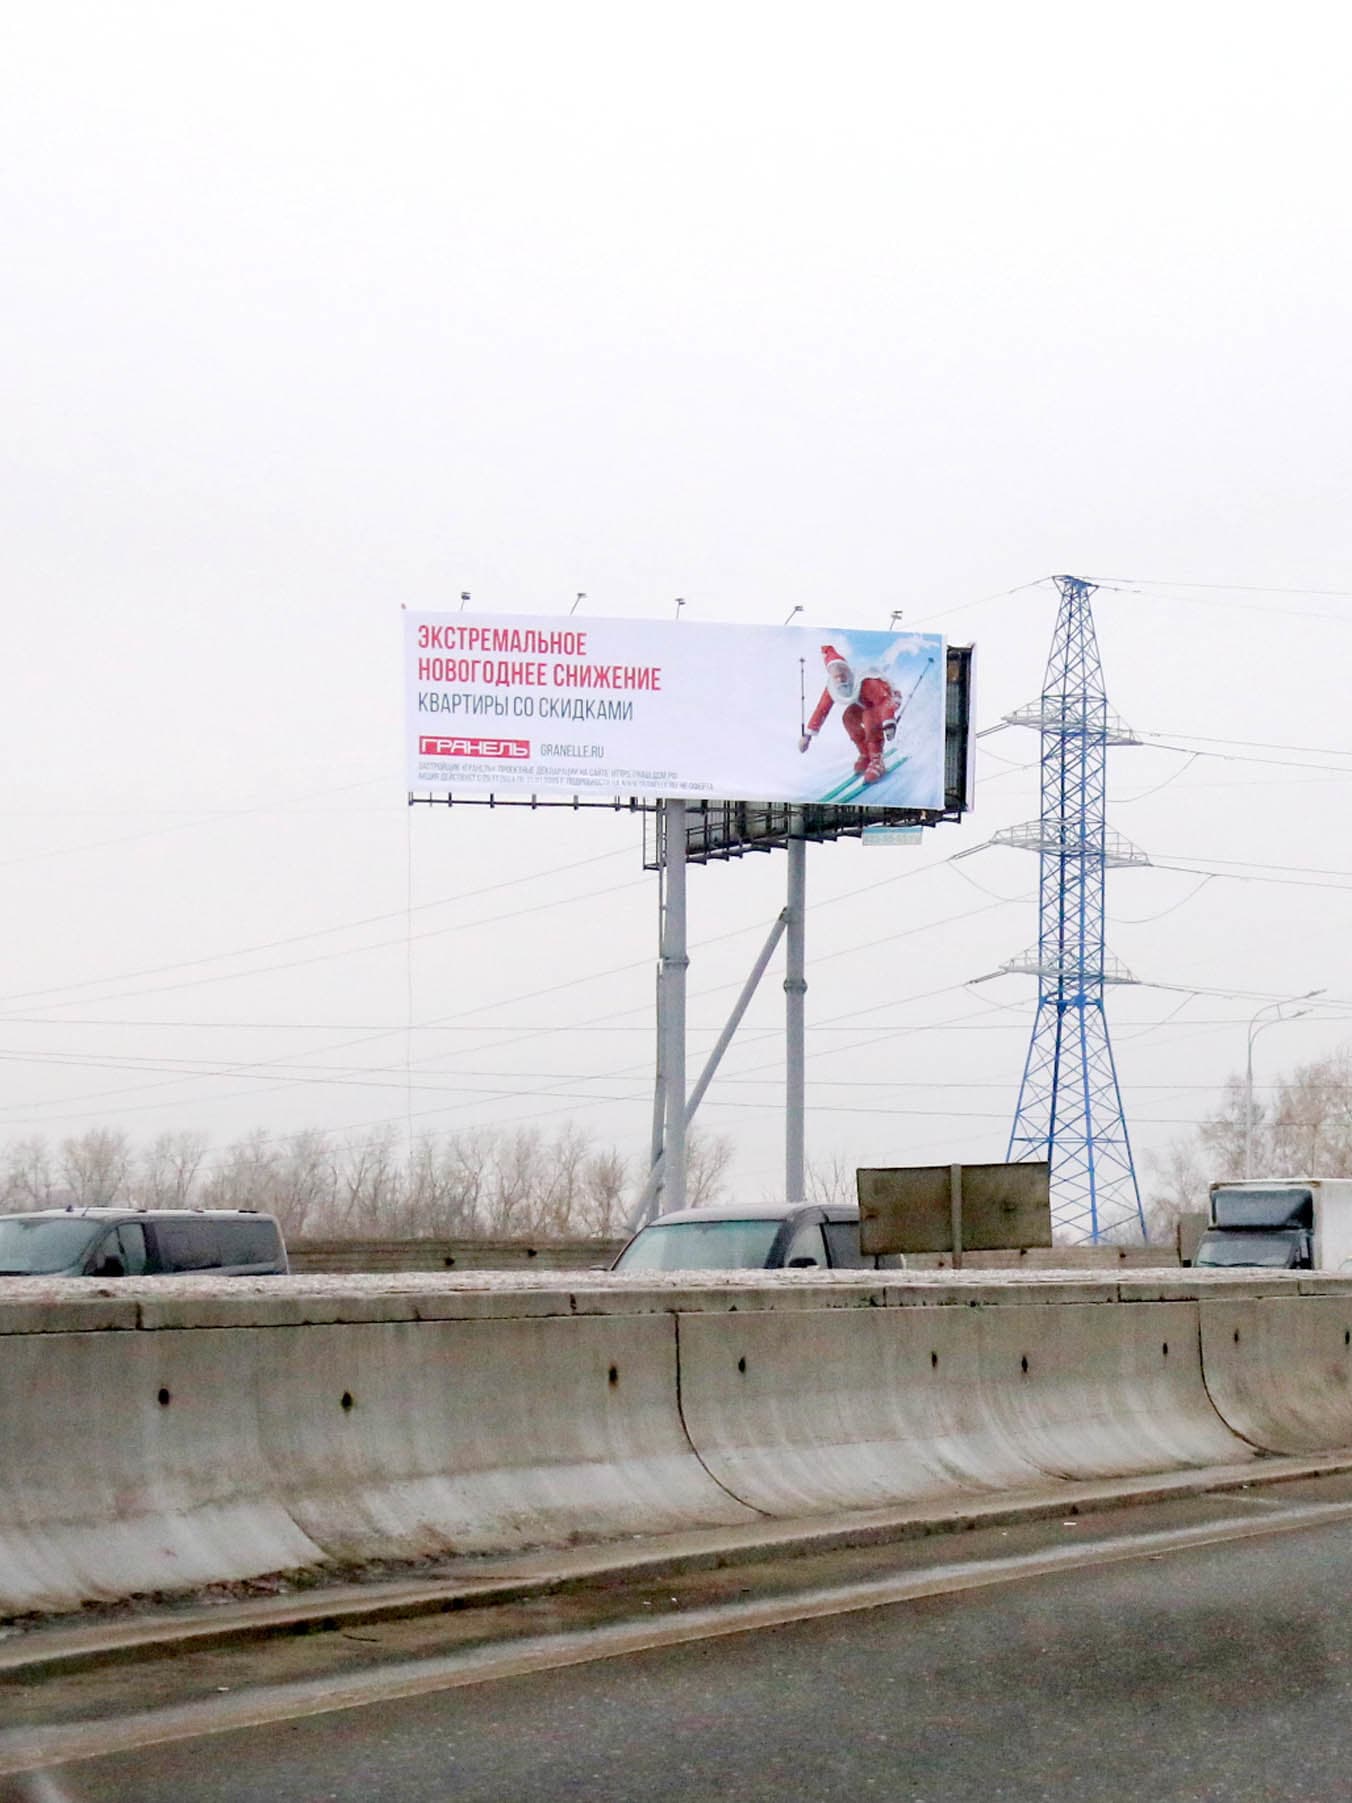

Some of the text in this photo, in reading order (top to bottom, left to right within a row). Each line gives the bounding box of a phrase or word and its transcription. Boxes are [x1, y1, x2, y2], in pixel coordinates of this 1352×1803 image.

[418, 625, 587, 656] ЭКСТРЕМАЛЬНОЕ
[418, 657, 661, 691] НОВОГОДНЕЕ СНИЖЕНИЕ
[418, 691, 633, 721] КВАРТИРЫ СО СКИДКАМИ
[421, 738, 529, 757] ГРАНЕЛЬ
[540, 743, 605, 759] GRANELLE.RU
